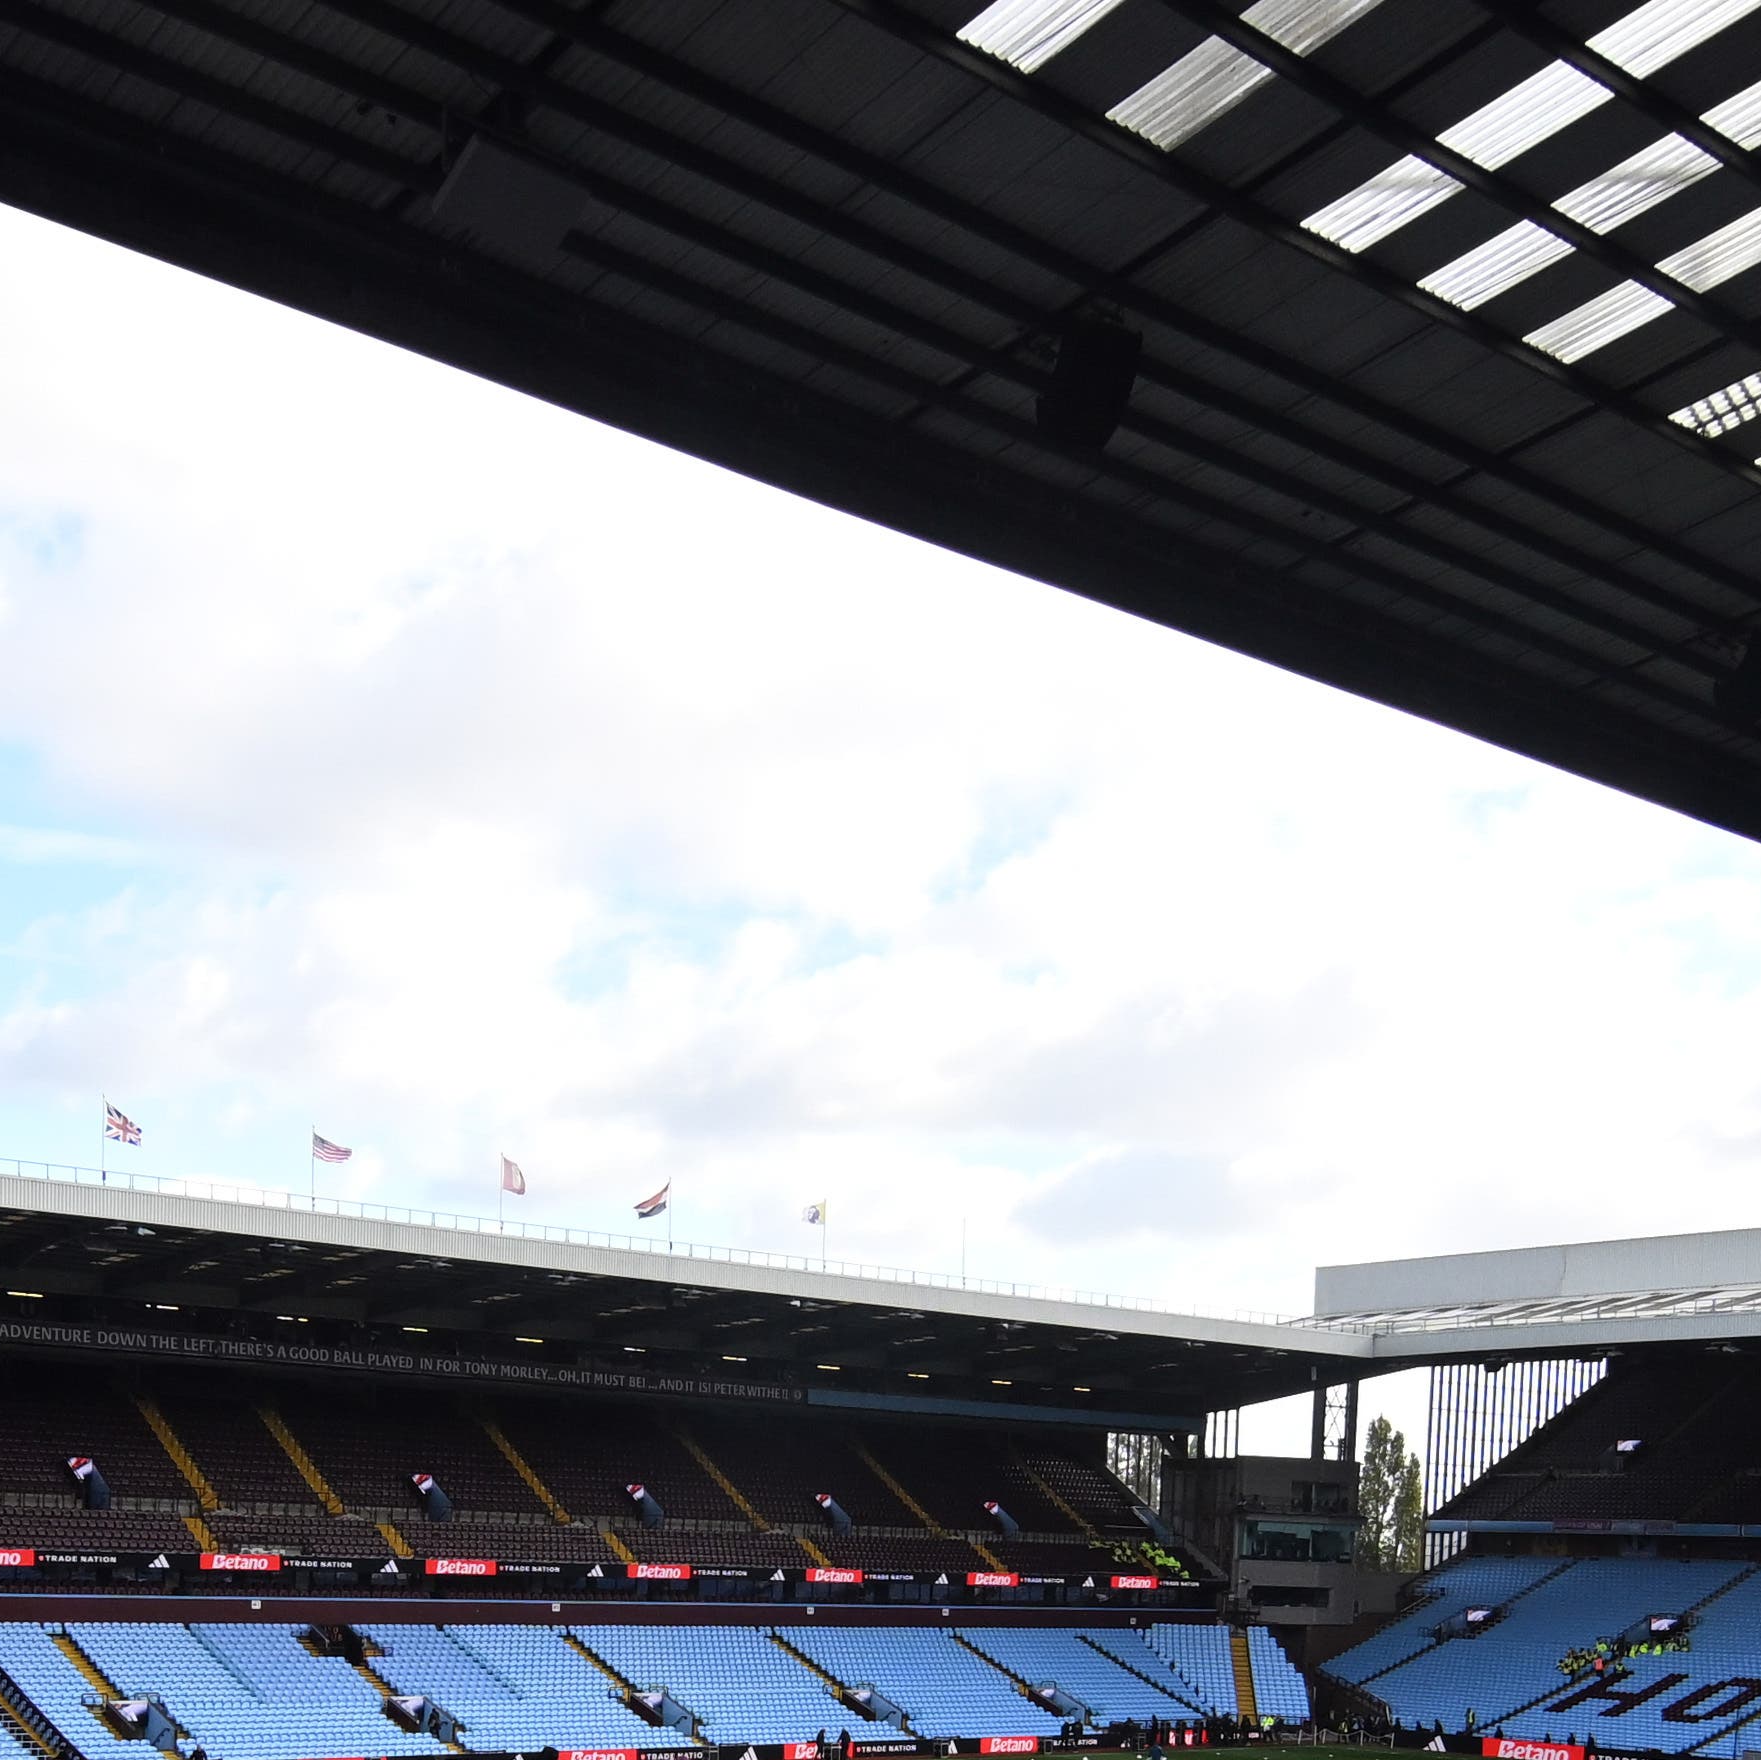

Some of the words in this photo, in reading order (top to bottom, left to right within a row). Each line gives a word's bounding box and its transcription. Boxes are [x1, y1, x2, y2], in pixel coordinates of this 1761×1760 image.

[0, 1323, 91, 1344] ADVENTURE
[97, 1330, 147, 1348] DOWN
[151, 1334, 178, 1351] THE
[221, 1340, 274, 1358] THERE'S
[277, 1345, 286, 1358] A
[289, 1346, 329, 1361] GOOD
[333, 1350, 365, 1365] BALL
[368, 1353, 413, 1368] PLAYED
[420, 1357, 433, 1370] IN
[436, 1358, 460, 1372] FOR
[463, 1361, 497, 1376] TONY
[581, 1372, 592, 1385] IT
[594, 1372, 625, 1387] MUST
[714, 1383, 746, 1396] PETER
[45, 1555, 78, 1563] TRADE
[80, 1556, 117, 1564] NATION
[212, 1554, 269, 1570] Betano
[289, 1560, 318, 1568] TRADE
[320, 1561, 353, 1569] NATION
[436, 1560, 486, 1575] Betano
[637, 1565, 681, 1579] Betano
[815, 1569, 855, 1582] Betano
[975, 1573, 1011, 1586] Betano
[1118, 1577, 1152, 1589] Betano
[990, 1738, 1034, 1753] Betano
